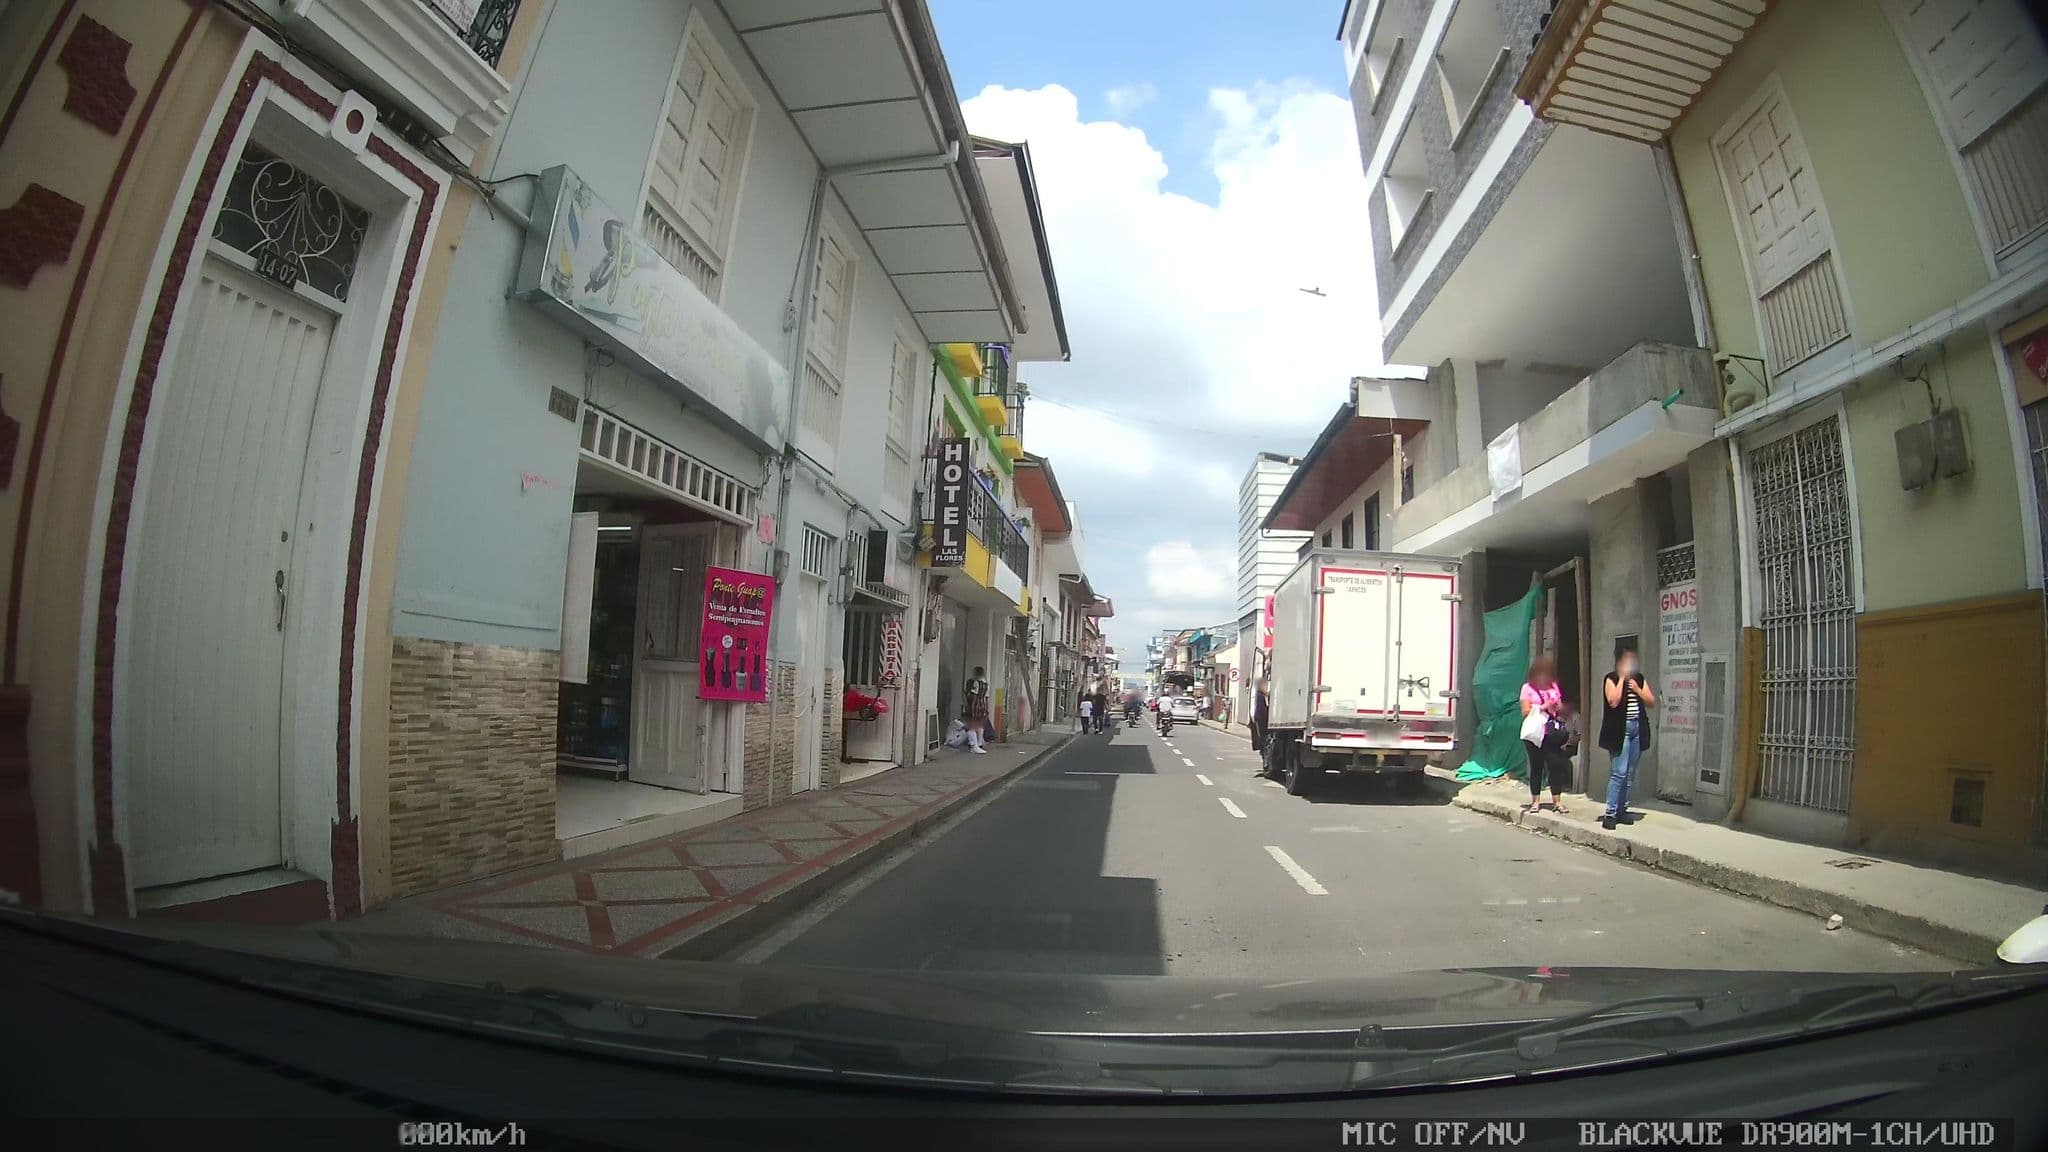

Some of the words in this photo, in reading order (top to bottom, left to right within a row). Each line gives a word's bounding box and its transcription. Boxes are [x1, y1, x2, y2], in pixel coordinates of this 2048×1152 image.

[260, 254, 297, 284] 14-07
[943, 443, 962, 546] HOTEL
[709, 602, 727, 611] Venta
[739, 606, 766, 616] Esmaltes
